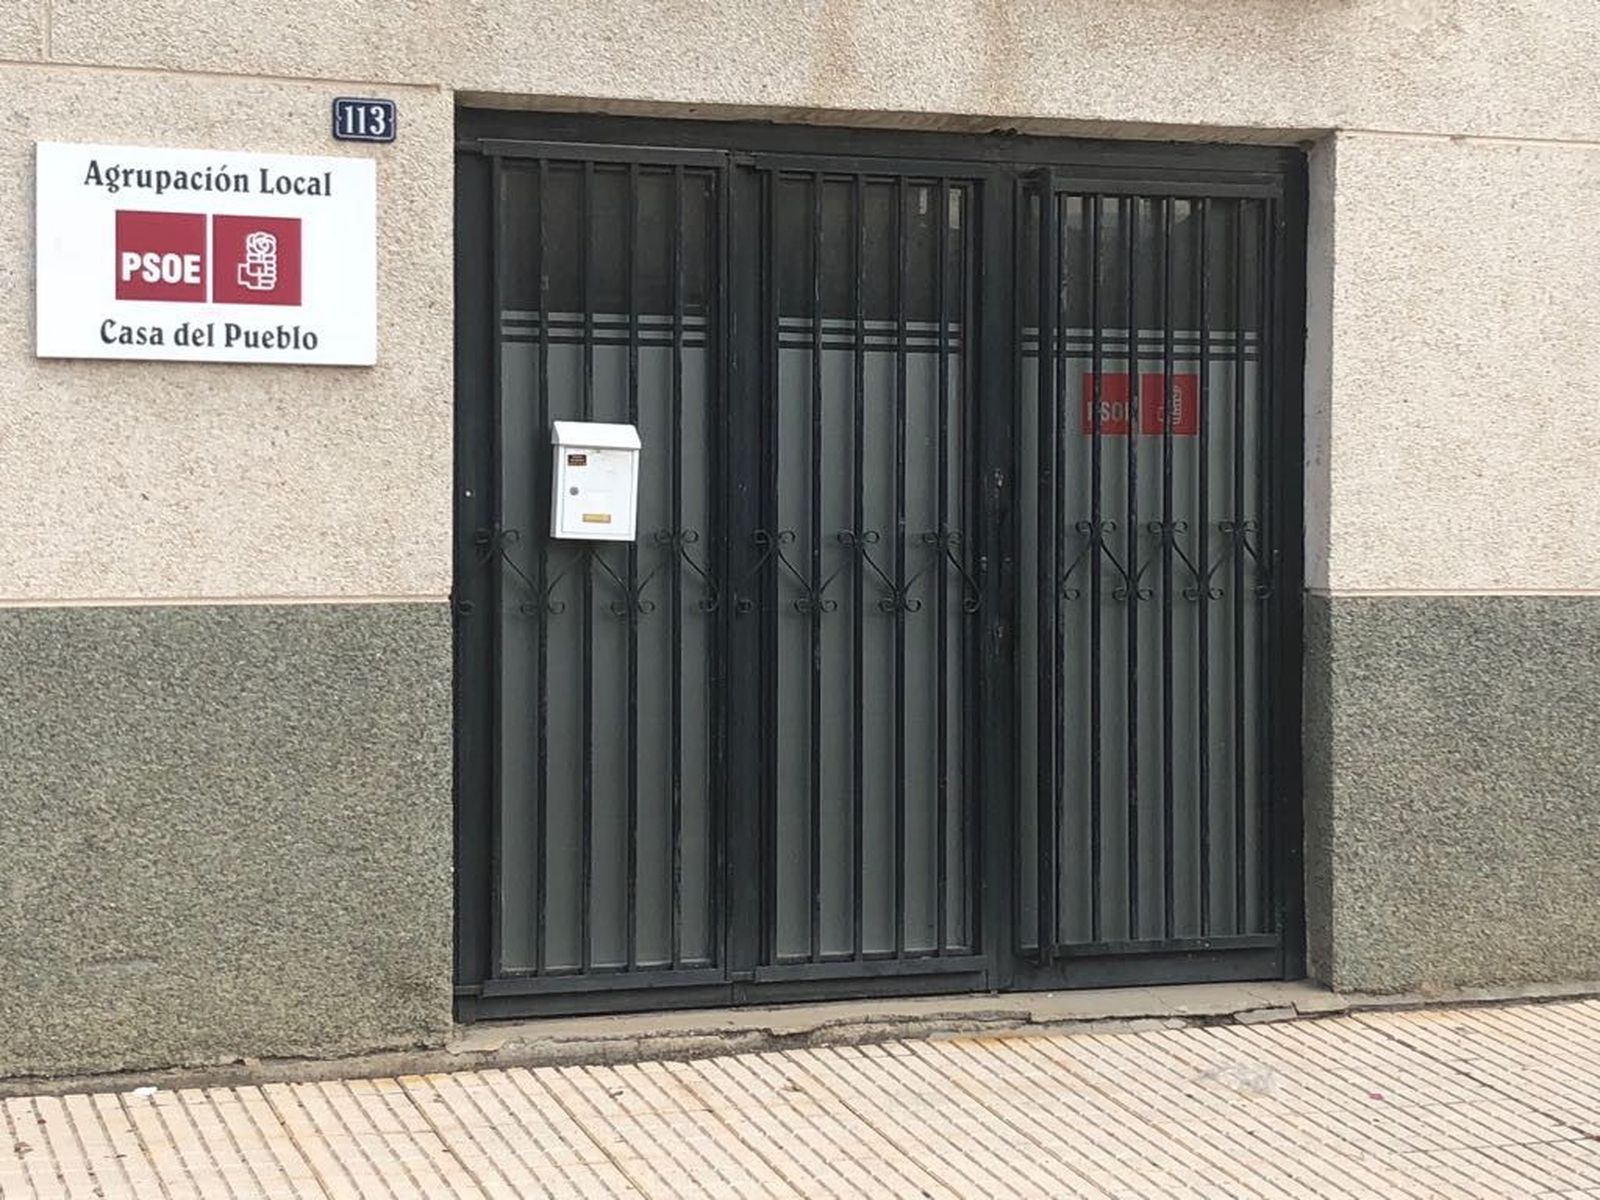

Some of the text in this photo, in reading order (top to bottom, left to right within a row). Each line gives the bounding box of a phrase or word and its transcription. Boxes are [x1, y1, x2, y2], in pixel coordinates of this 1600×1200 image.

[344, 105, 386, 135] 113
[84, 160, 332, 197] Agrupación Local
[121, 252, 201, 284] PSOE
[100, 319, 318, 350] Casa del Pueblo
